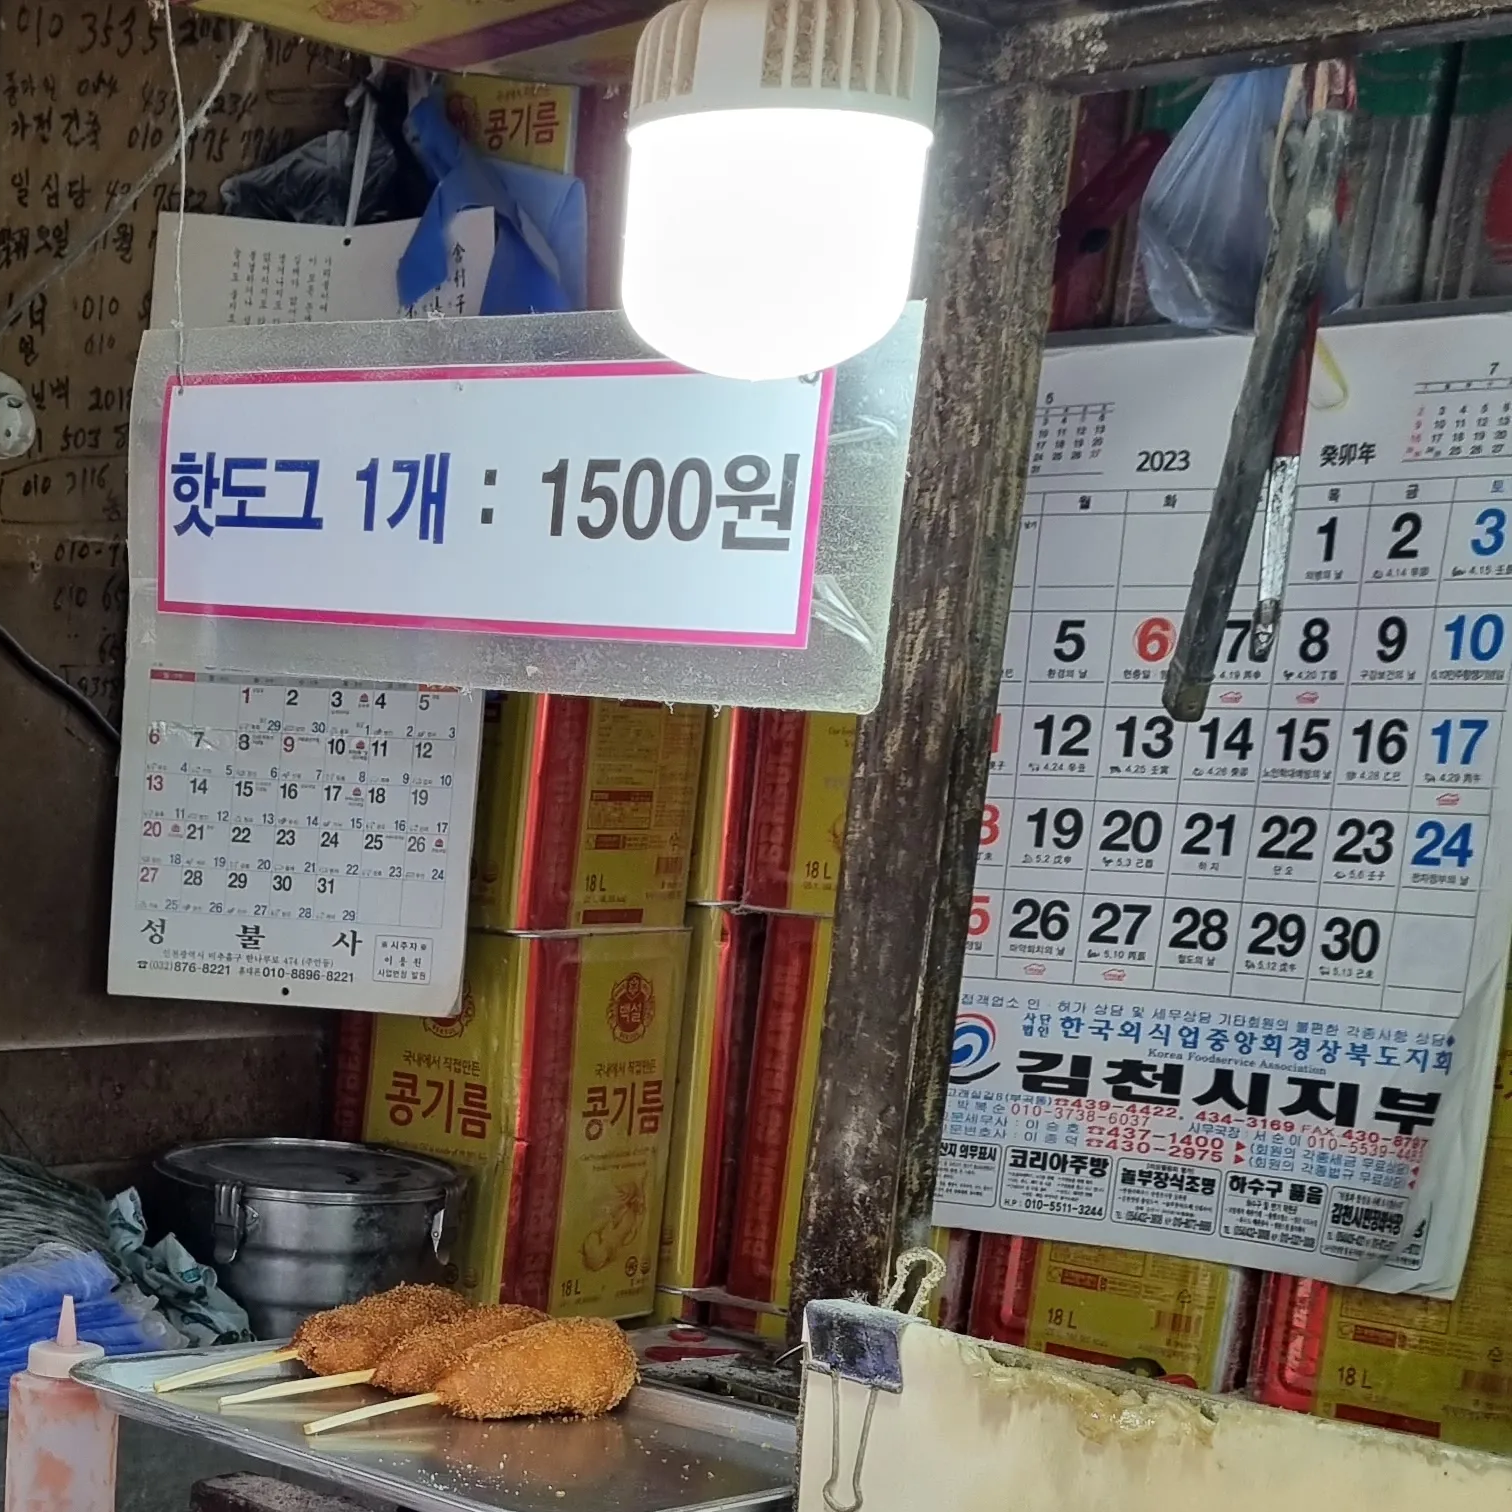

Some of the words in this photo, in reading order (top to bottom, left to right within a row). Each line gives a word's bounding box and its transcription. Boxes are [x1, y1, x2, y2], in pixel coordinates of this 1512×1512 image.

[484, 100, 560, 151] 콩기름
[1135, 450, 1191, 472] 2023
[171, 452, 323, 538] 핫도그
[356, 453, 449, 545] 1개
[541, 453, 801, 551] 1500원
[1317, 515, 1338, 562] 1
[1387, 512, 1423, 560] 2
[1470, 508, 1507, 557] 3
[1054, 619, 1086, 662] 5
[1136, 618, 1171, 662] 6
[1225, 619, 1251, 663] 7
[1299, 617, 1330, 663] 8
[1376, 615, 1407, 663] 9
[1444, 613, 1505, 661] 10
[242, 687, 251, 703] 1
[286, 689, 298, 706] 2
[331, 690, 343, 708] 3
[375, 692, 387, 709] 4
[418, 694, 429, 710] 5
[267, 720, 281, 731] 29
[312, 722, 326, 733] 30
[1033, 714, 1092, 757] 12
[1115, 715, 1175, 759] 13
[1199, 716, 1254, 760] 14
[1276, 717, 1330, 763] 15
[1352, 718, 1408, 764] 16
[1431, 719, 1489, 765] 17
[149, 728, 160, 745] 6
[194, 731, 204, 748] 7
[238, 734, 250, 751] 8
[283, 736, 295, 753] 9
[328, 738, 345, 755] 10
[372, 739, 388, 757] 11
[415, 742, 433, 759] 12
[146, 775, 164, 791] 13
[190, 778, 208, 795] 14
[235, 780, 253, 797] 15
[280, 782, 298, 800] 16
[324, 785, 342, 801] 17
[368, 788, 386, 804] 18
[411, 789, 429, 806] 19
[175, 808, 185, 819] 11
[217, 810, 229, 821] 12
[262, 813, 274, 824] 13
[306, 815, 319, 827] 14
[351, 818, 362, 829] 15
[394, 820, 406, 831] 16
[437, 822, 448, 833] 17
[143, 820, 162, 837] 20
[186, 824, 204, 840] 21
[231, 826, 251, 844] 22
[276, 829, 296, 846] 23
[320, 832, 339, 848] 24
[364, 834, 383, 850] 25
[407, 836, 426, 853] 26
[1026, 807, 1084, 851] 19
[1099, 809, 1163, 854] 20
[1180, 812, 1236, 857] 21
[1257, 815, 1318, 861] 22
[1332, 818, 1395, 865] 23
[1410, 820, 1473, 867] 24
[140, 866, 159, 883] 27
[183, 870, 203, 886] 28
[227, 872, 248, 889] 29
[272, 875, 292, 892] 30
[317, 878, 335, 894] 31
[805, 860, 820, 879] 18
[824, 862, 832, 880] L
[165, 899, 178, 910] 25
[209, 902, 223, 914] 26
[254, 904, 267, 916] 27
[298, 907, 312, 919] 28
[342, 910, 355, 921] 29
[140, 918, 166, 945] 성
[235, 924, 266, 950] 불
[332, 929, 363, 957] 사
[1008, 898, 1071, 942] 26
[1087, 902, 1152, 946] 27
[1168, 906, 1229, 952] 28
[1246, 911, 1307, 958] 29
[1320, 916, 1381, 964] 30
[619, 1001, 642, 1023] 백설
[1023, 1013, 1052, 1025] 사단
[1094, 1003, 1124, 1018] 상담
[1131, 1005, 1144, 1019] 및
[1151, 1007, 1211, 1025] 세무상담
[1218, 1013, 1289, 1032] 기타회원의
[1022, 1024, 1050, 1038] 법인
[1147, 1048, 1183, 1061] Korea
[1187, 1051, 1256, 1068] Foodservice
[1258, 1059, 1326, 1076] Association
[385, 1070, 492, 1140] 콩기름
[1016, 1050, 1442, 1136] 김천시지부
[582, 1080, 664, 1141] 콩기름
[1011, 1103, 1150, 1127] 010-3738-6037
[1195, 1110, 1295, 1133] 434-3169
[1105, 1139, 1224, 1162] 430-2975
[1106, 1127, 1225, 1149] 437-1400
[959, 1143, 998, 1162] 의무표시
[1008, 1148, 1110, 1178] 코리아주방
[1229, 1174, 1283, 1199] 하수구
[1024, 1198, 1104, 1218] 010-5511-3244
[1047, 1307, 1063, 1326] 18
[1068, 1310, 1077, 1330] L
